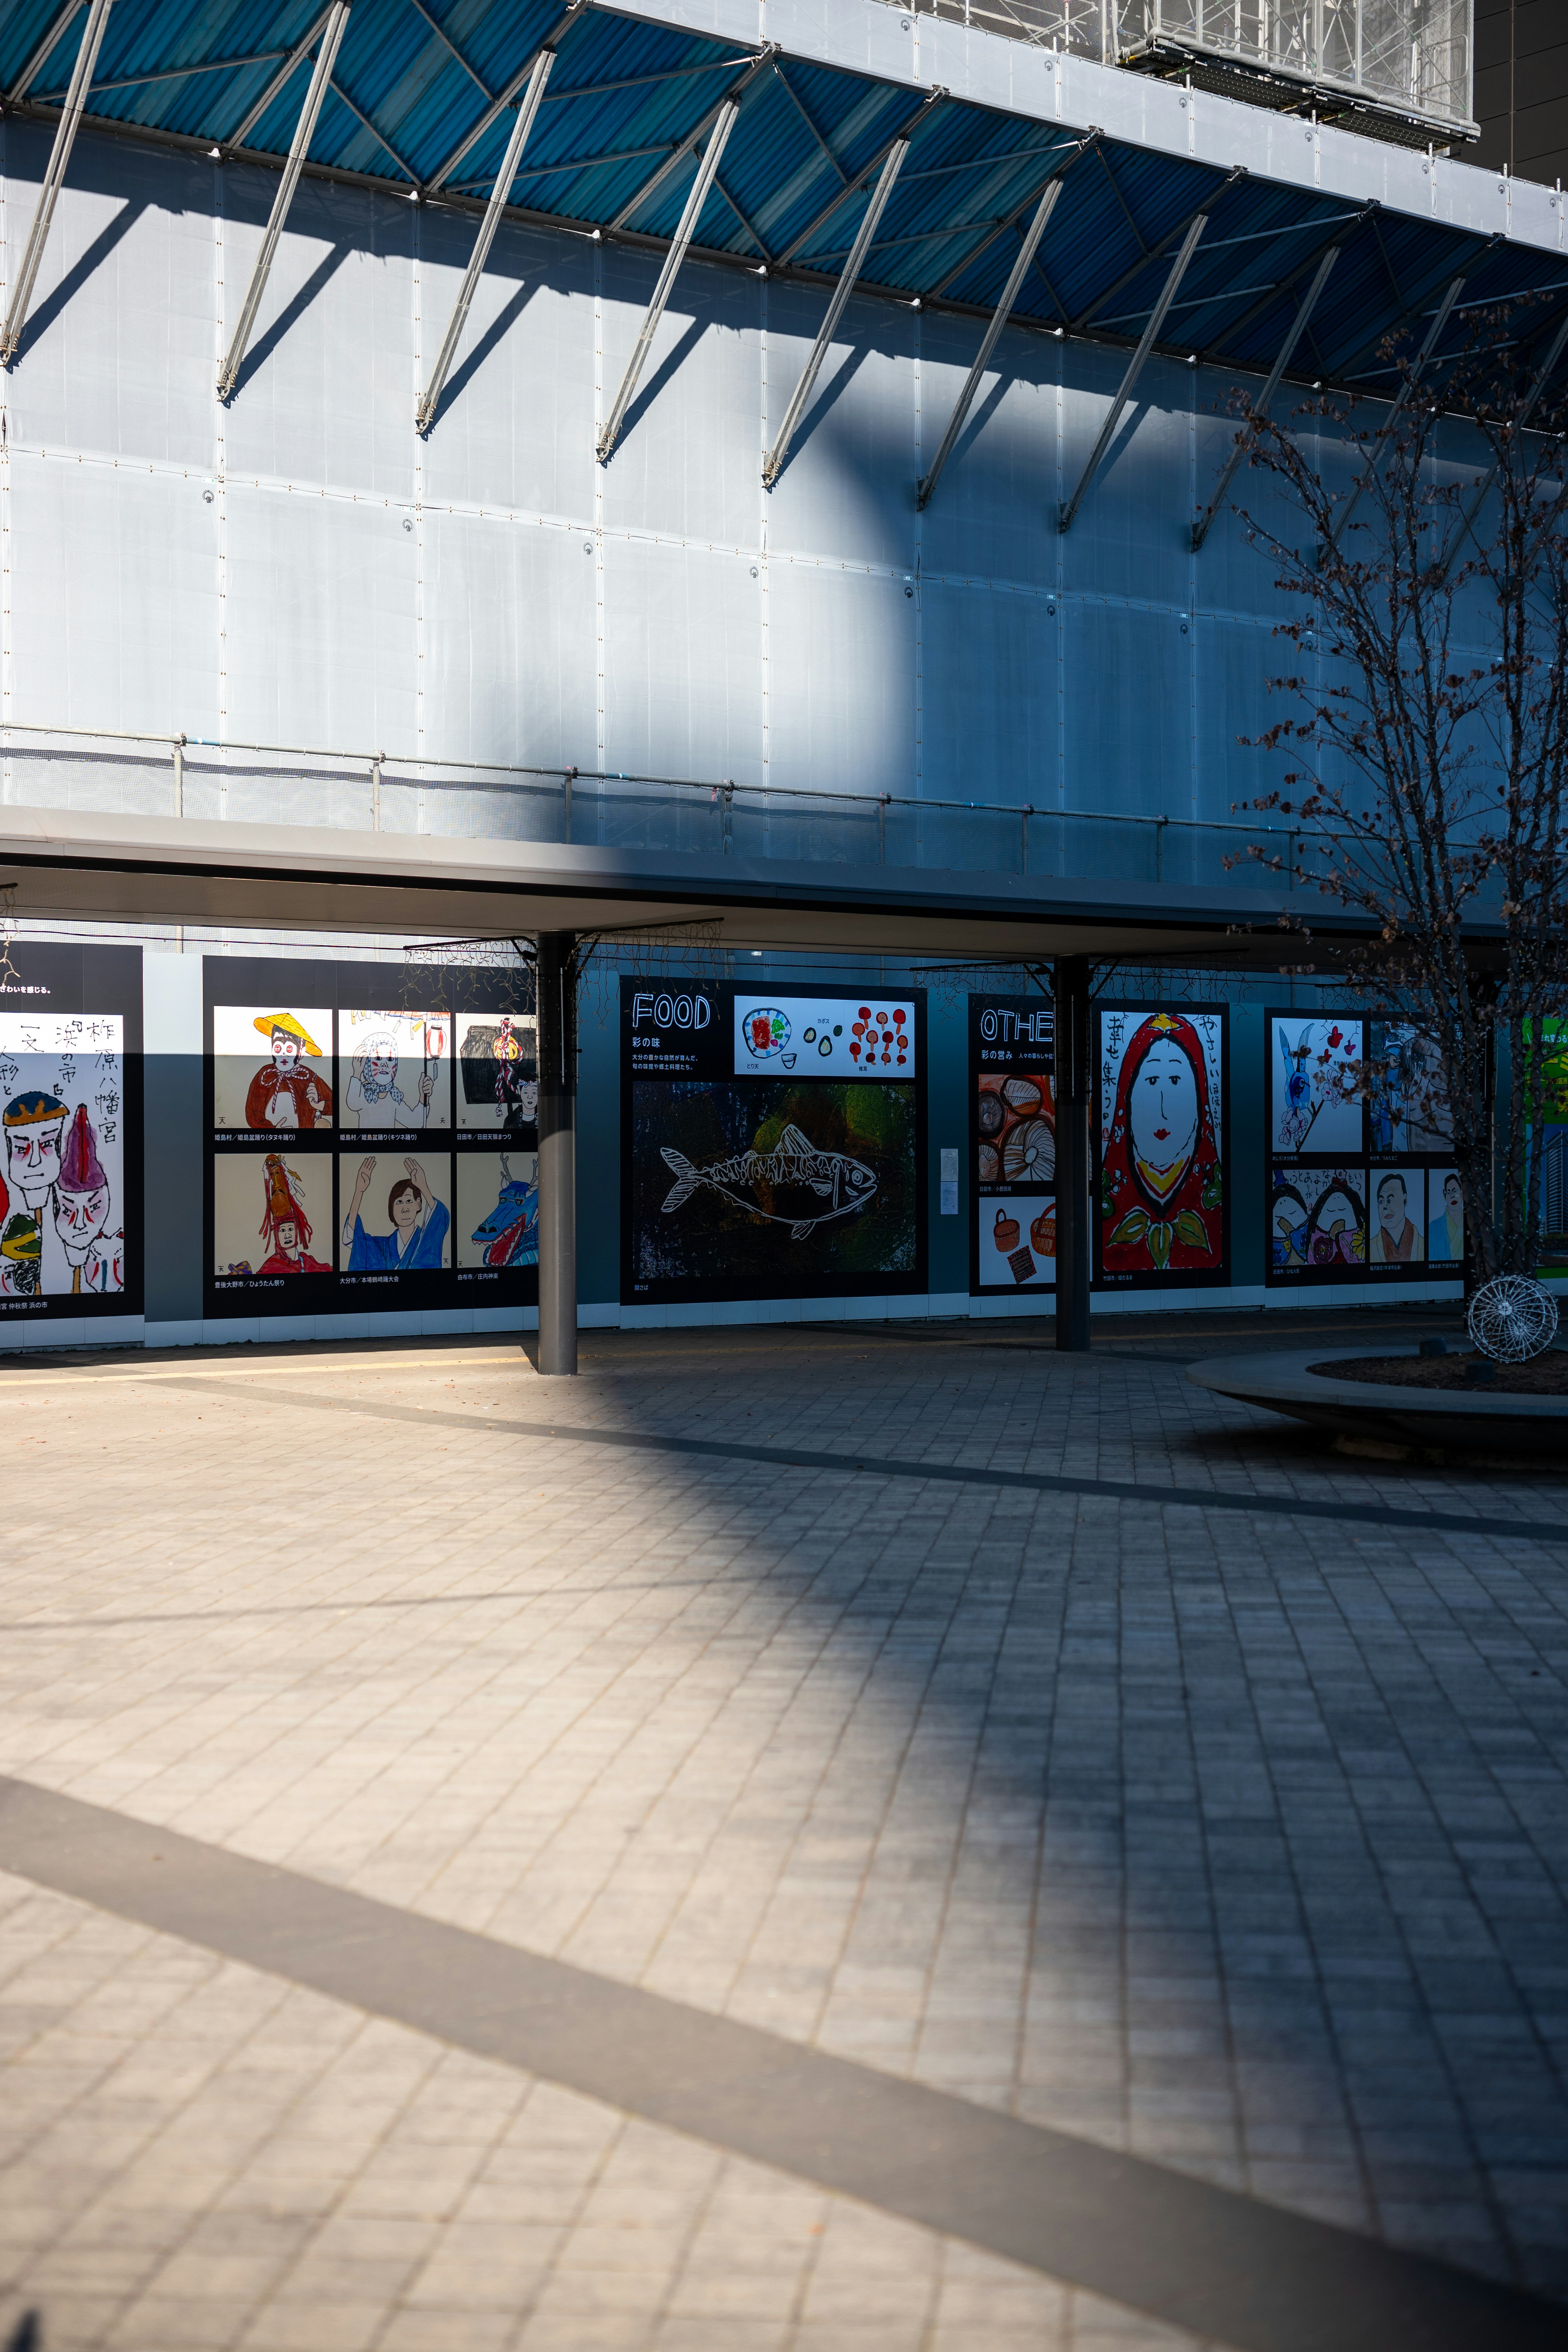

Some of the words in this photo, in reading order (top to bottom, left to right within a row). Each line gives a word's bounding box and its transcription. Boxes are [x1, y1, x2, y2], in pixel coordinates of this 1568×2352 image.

[0, 985, 51, 994] ぎわいを感じる。
[632, 993, 710, 1029] FOOD
[632, 1037, 660, 1048] 彩の味
[1541, 1034, 1568, 1043] れ変わる
[982, 1050, 1013, 1060] 彩の営み
[215, 1280, 284, 1288] 豊後大野市／ひょうたん祭り
[340, 1276, 399, 1284] 大分市／本場鶴崎踊大会
